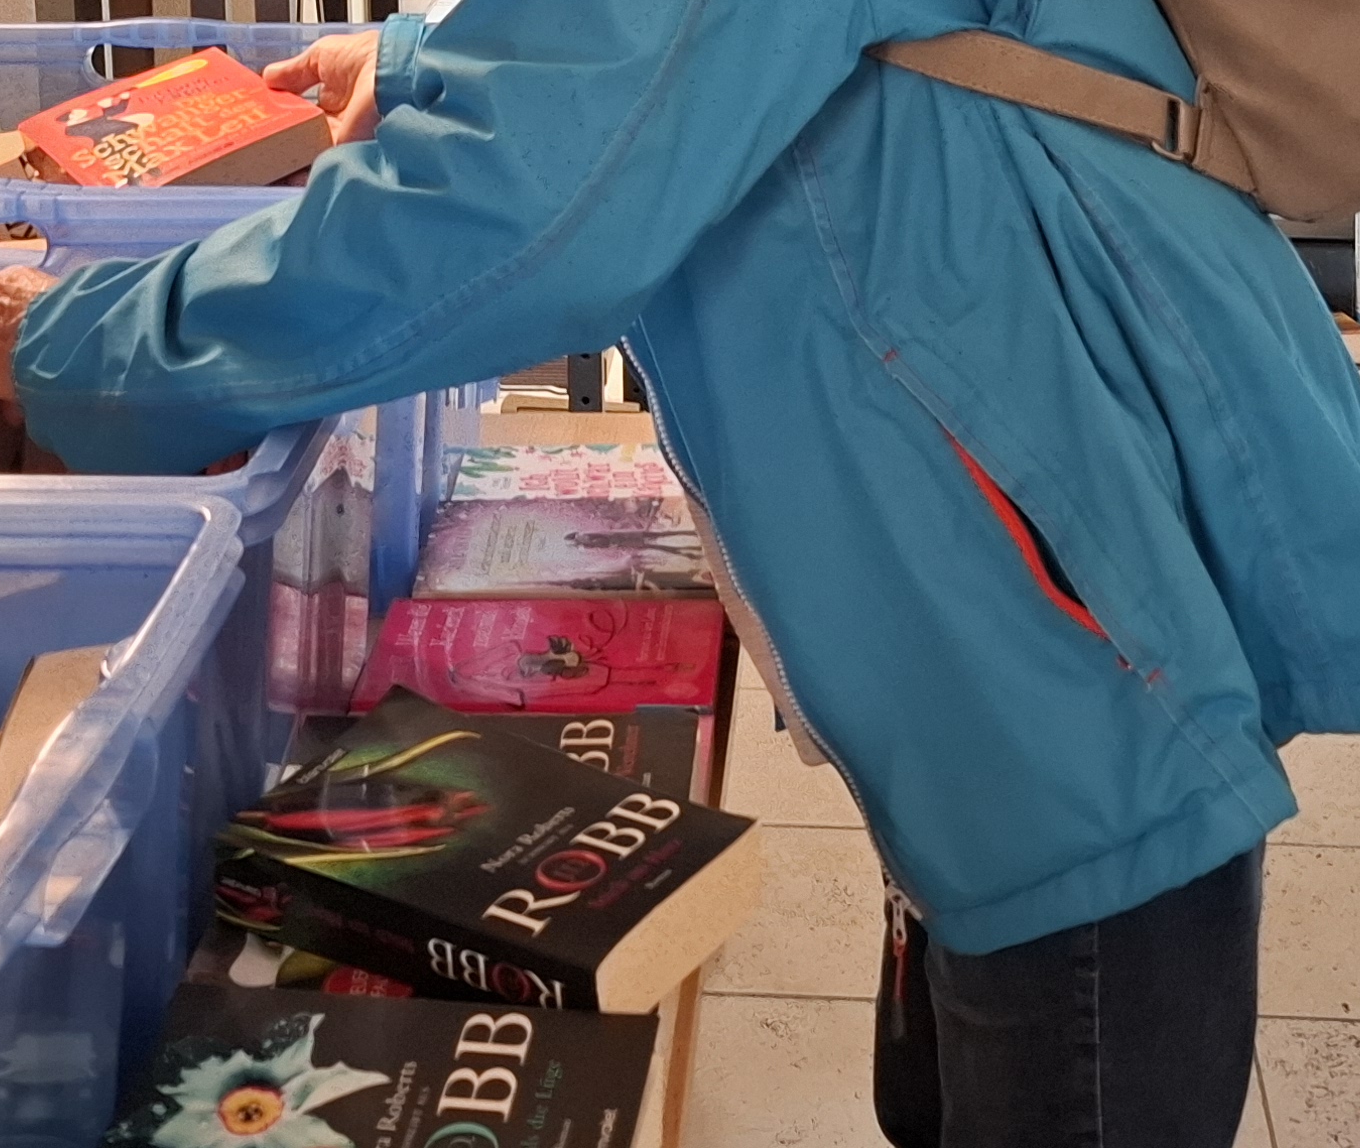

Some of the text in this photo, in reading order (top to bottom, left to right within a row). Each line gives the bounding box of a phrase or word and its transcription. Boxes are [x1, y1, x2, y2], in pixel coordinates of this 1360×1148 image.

[101, 104, 271, 189] Max Leif
[481, 790, 682, 939] ROBB
[378, 1061, 418, 1133] Roberts
